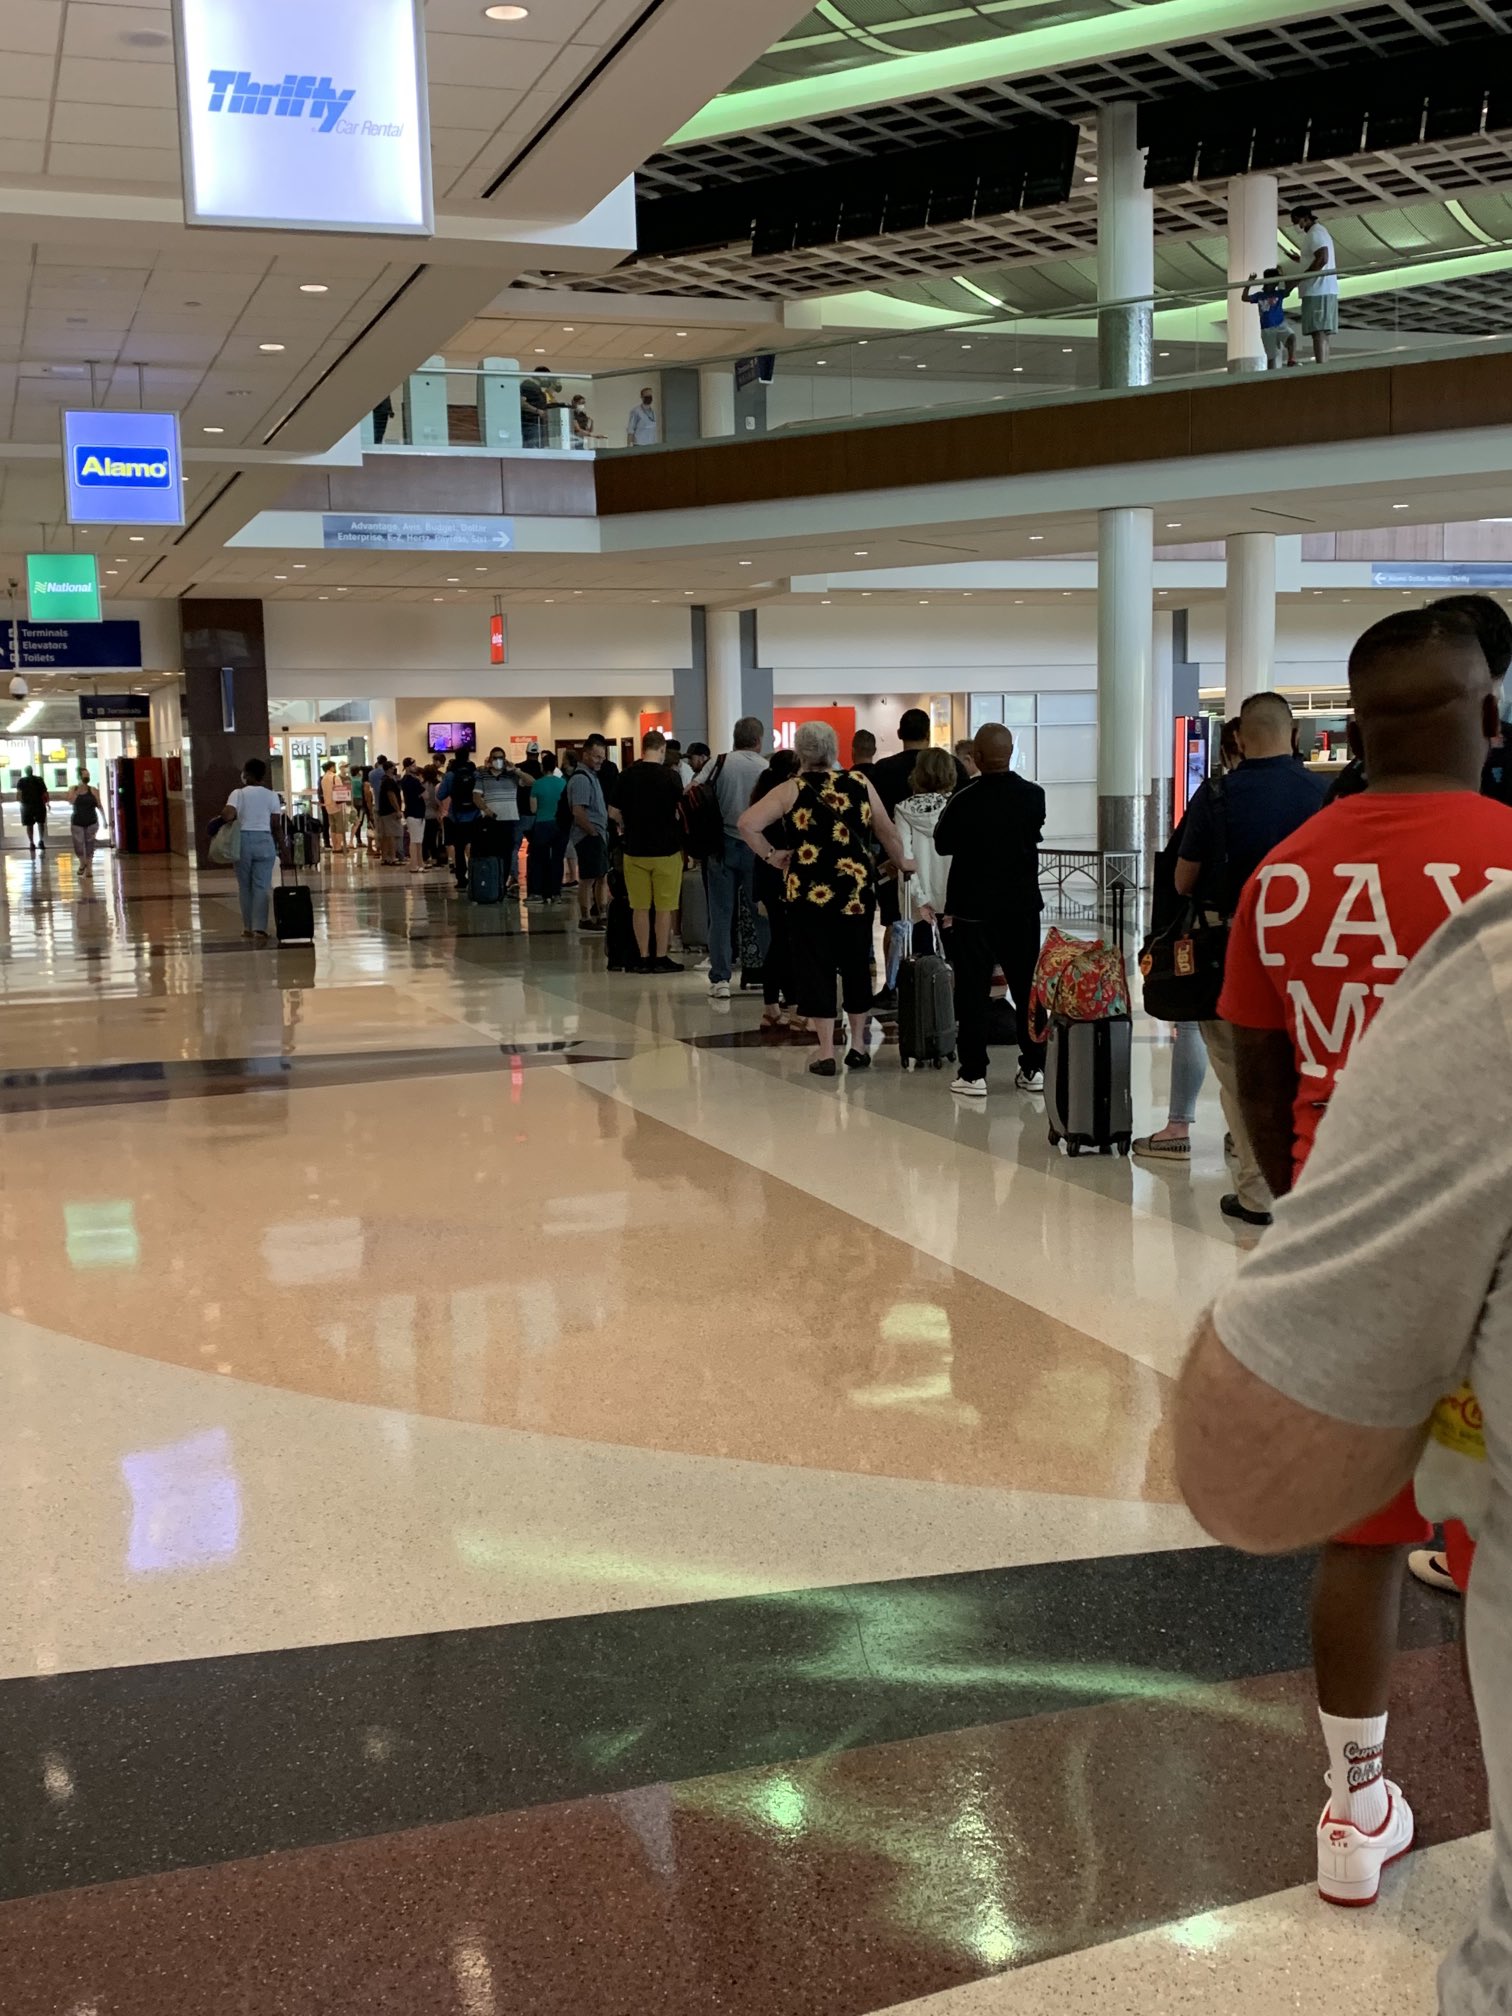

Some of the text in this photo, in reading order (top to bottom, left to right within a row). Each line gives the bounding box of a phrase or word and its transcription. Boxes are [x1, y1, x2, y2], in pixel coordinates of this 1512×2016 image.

[208, 69, 356, 132] Thrifty
[335, 119, 404, 137] Car Rental
[81, 456, 167, 478] Alamo
[46, 582, 92, 593] National
[21, 628, 69, 638] Terminals
[22, 641, 68, 650] Elevators
[23, 654, 55, 662] Toilets
[1286, 980, 1398, 1079] M
